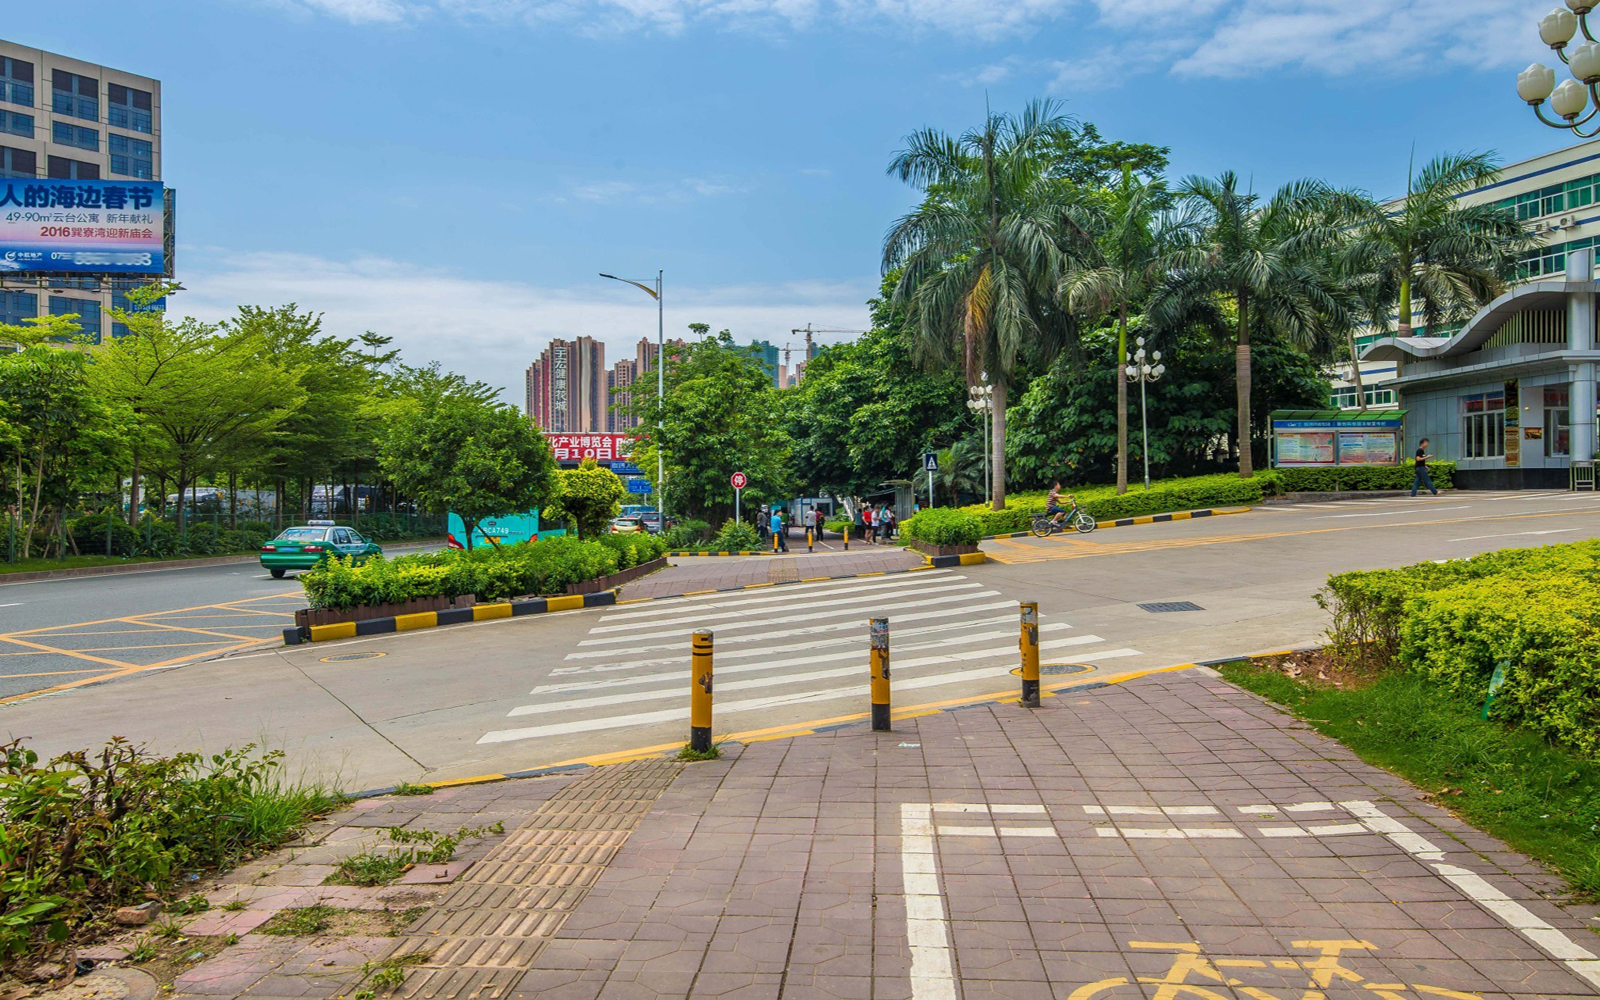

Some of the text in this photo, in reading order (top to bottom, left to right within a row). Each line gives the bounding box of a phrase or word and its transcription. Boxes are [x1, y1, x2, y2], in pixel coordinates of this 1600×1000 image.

[0, 183, 154, 210] 人的海边春节
[106, 212, 154, 224] 新年献礼
[40, 226, 153, 239] 2016巽寮湾迎新庙会
[735, 475, 744, 486] 停
